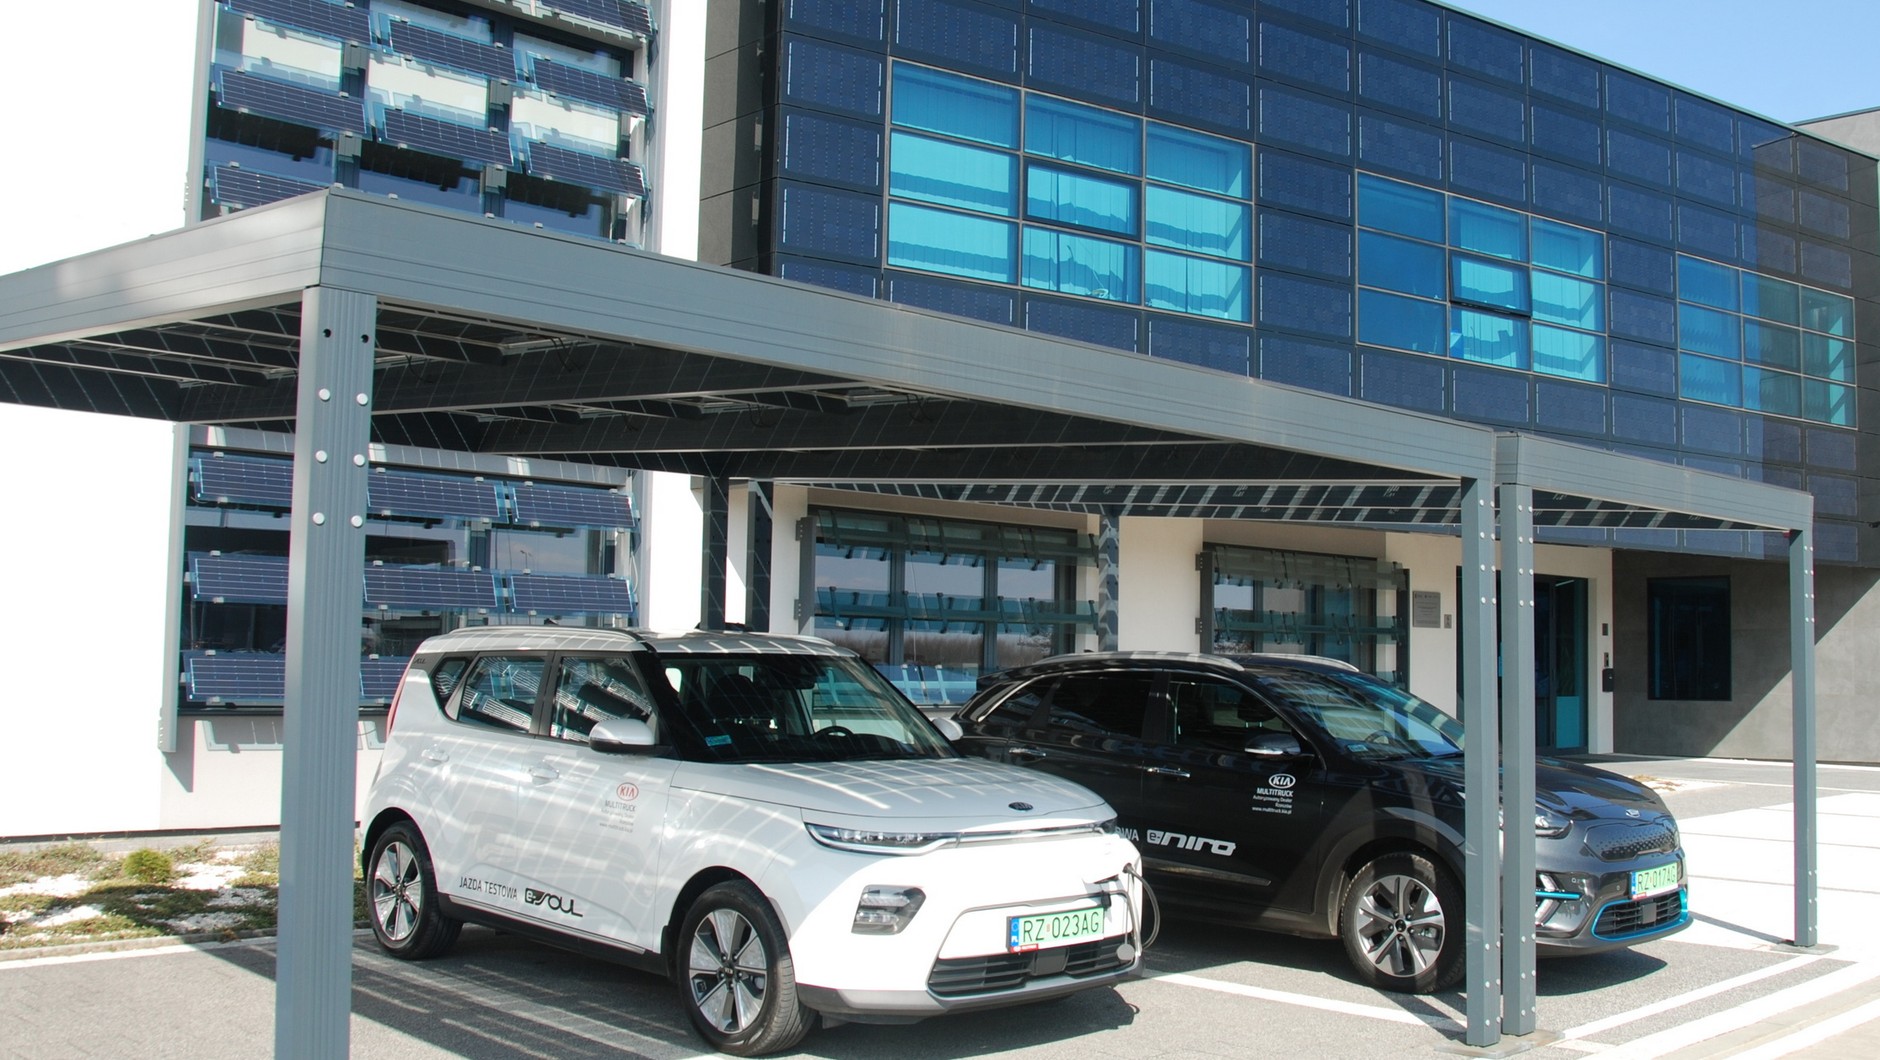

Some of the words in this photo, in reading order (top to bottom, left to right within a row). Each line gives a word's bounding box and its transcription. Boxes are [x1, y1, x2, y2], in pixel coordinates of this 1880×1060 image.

[1256, 787, 1294, 797] MULTITRUCK
[459, 876, 482, 892] JAZDA
[484, 881, 518, 901] TESTOWA
[1638, 873, 1650, 892] RZ
[1023, 918, 1045, 943] RZ
[1051, 911, 1100, 938] 023AG
